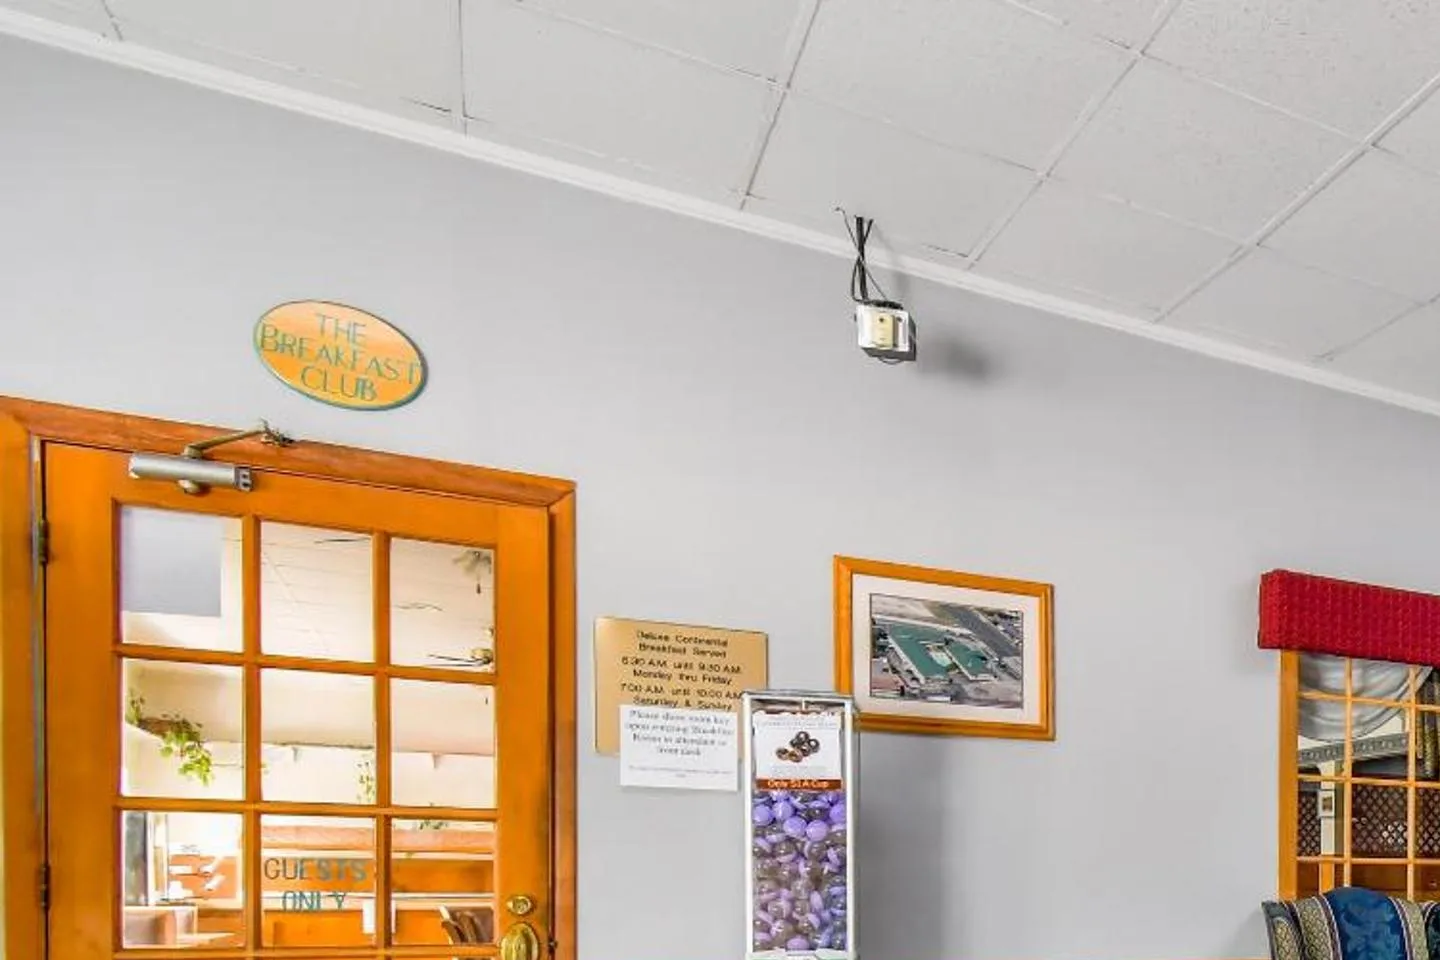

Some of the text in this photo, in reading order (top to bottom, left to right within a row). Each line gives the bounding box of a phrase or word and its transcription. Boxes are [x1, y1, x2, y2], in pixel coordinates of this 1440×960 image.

[313, 312, 367, 348] THE
[260, 323, 421, 385] BREAKFAST
[300, 365, 378, 402] CLUB
[637, 630, 729, 648] Deluxe Continental
[638, 642, 727, 659] Breakfast Served
[673, 661, 693, 670] until
[633, 669, 733, 686] Monday thru Friday
[671, 687, 691, 697] until
[633, 696, 679, 708] Saturday
[697, 700, 732, 711] Sunday
[264, 857, 368, 881] GUESTS
[282, 890, 347, 912] ONLY
